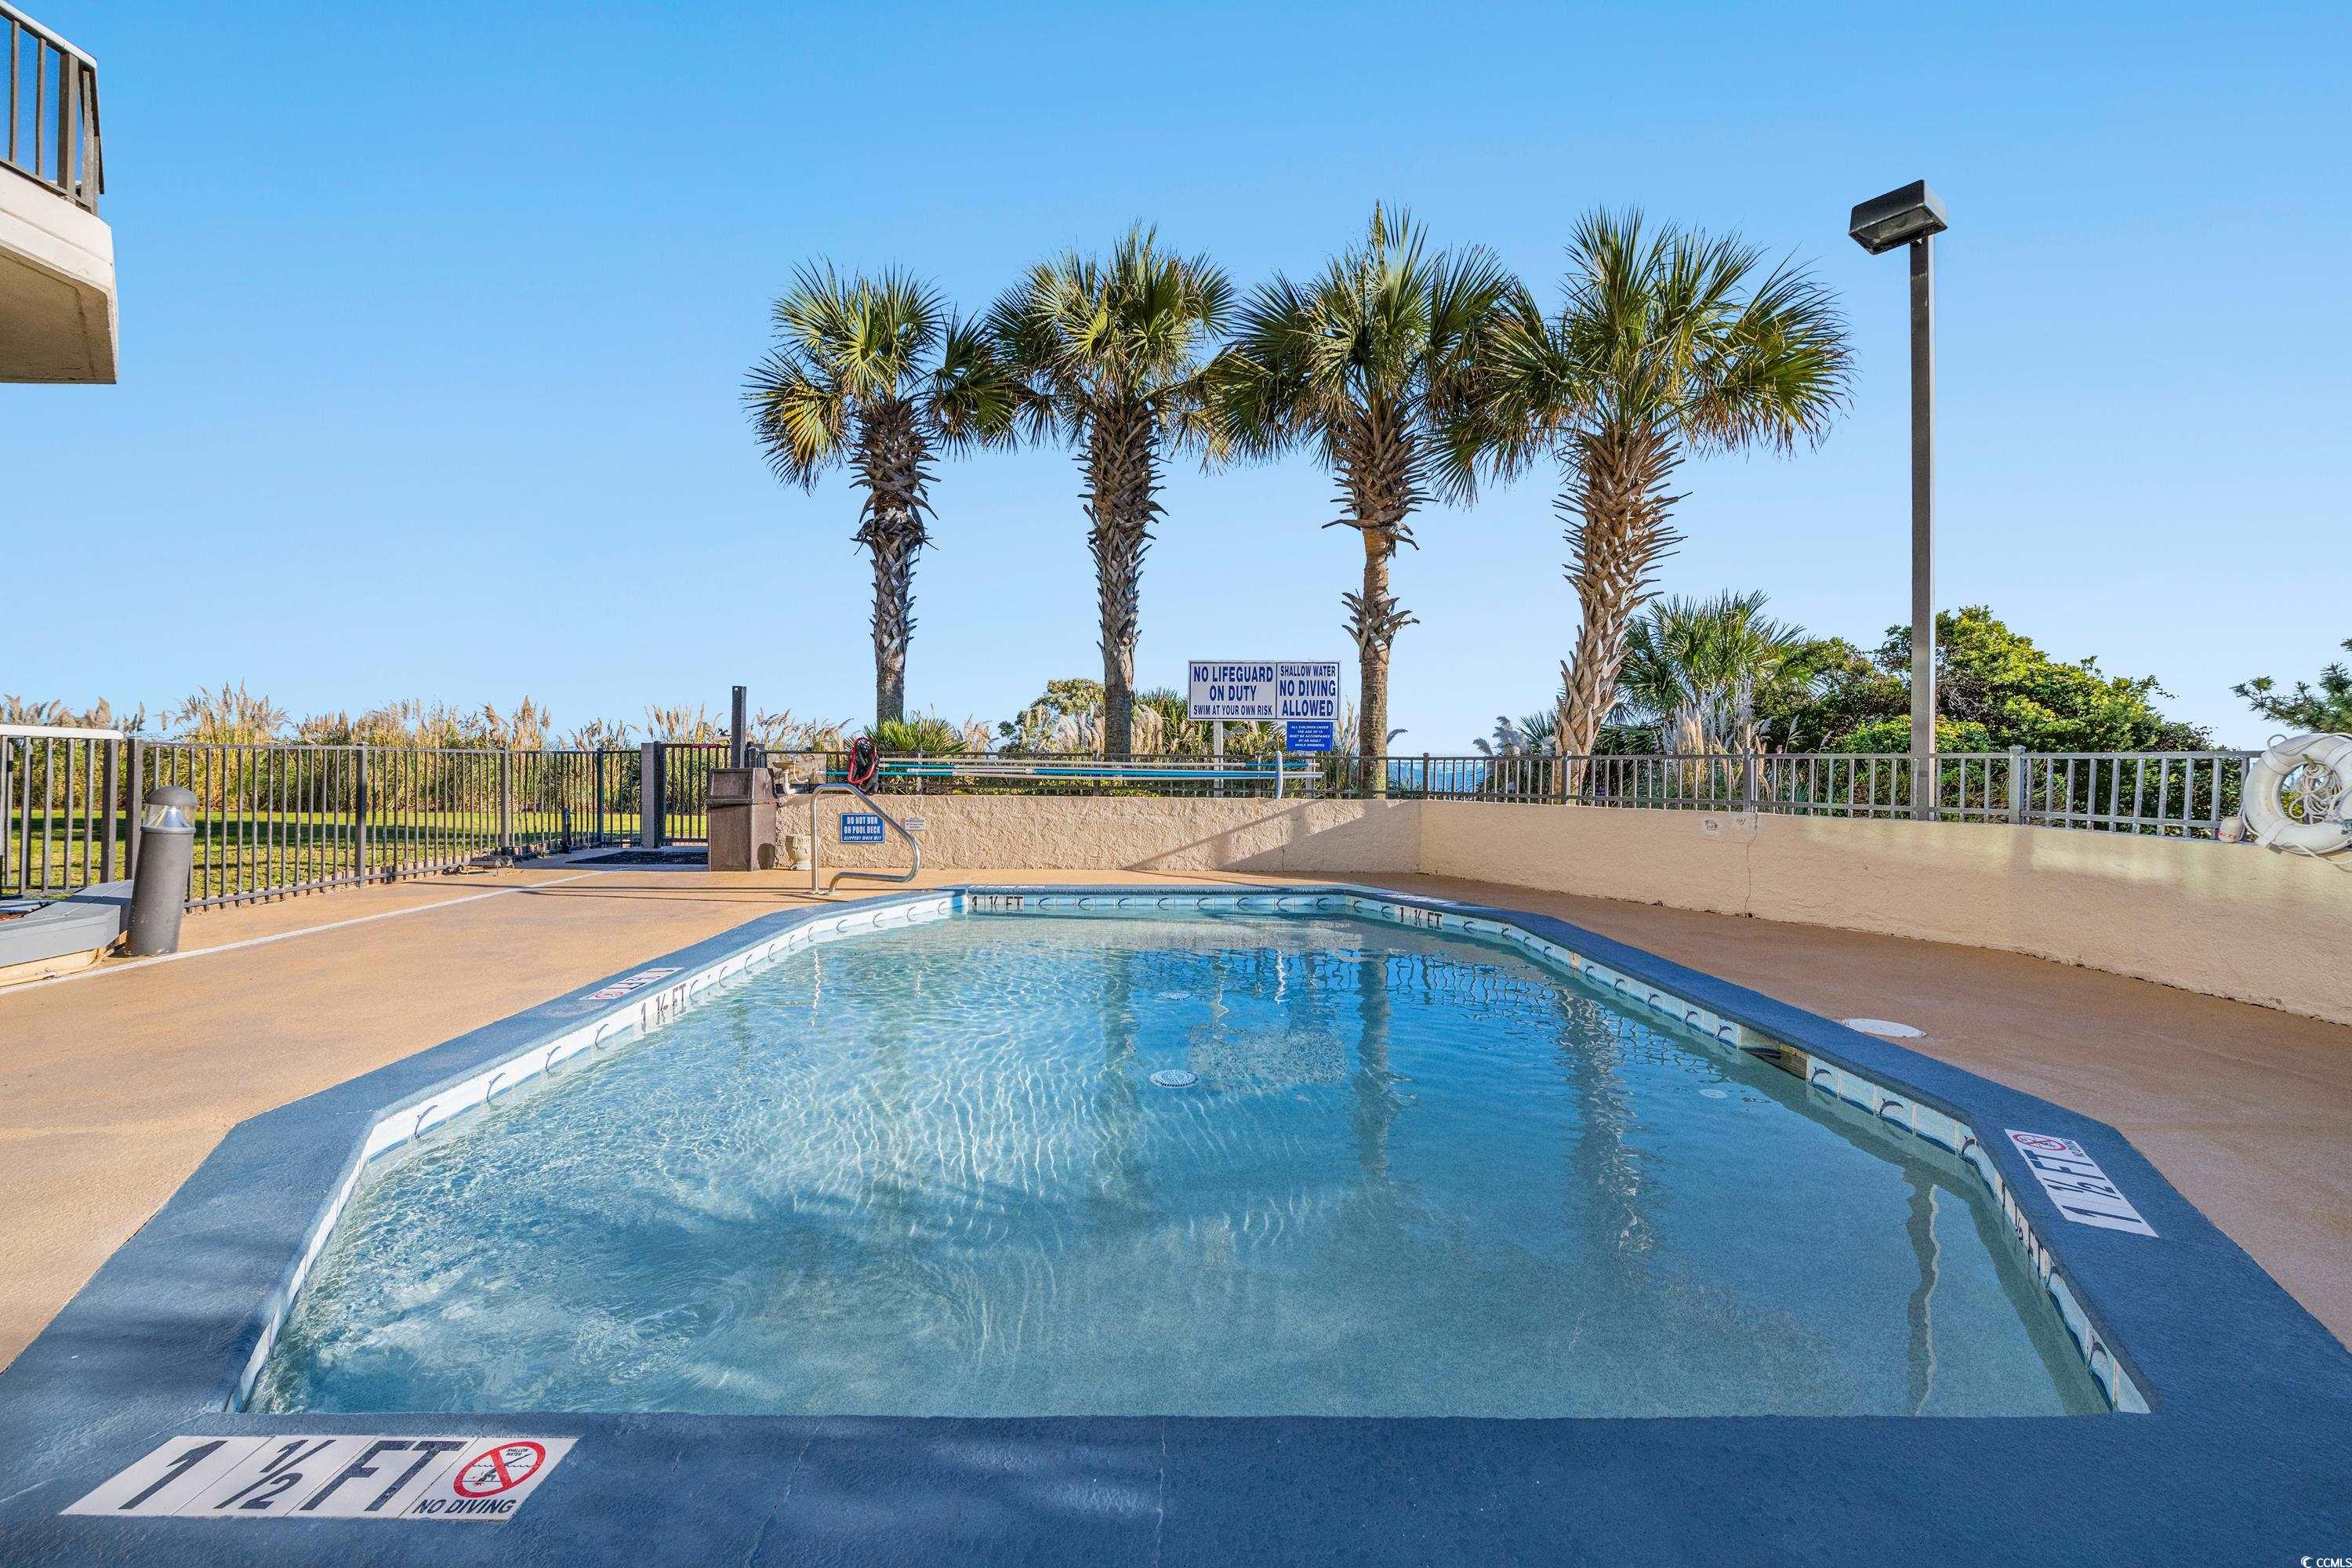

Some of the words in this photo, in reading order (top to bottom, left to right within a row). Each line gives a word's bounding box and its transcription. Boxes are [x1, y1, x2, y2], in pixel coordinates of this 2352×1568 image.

[1193, 666, 1209, 682] NO
[1212, 666, 1273, 682] LIFEGUARD
[1280, 666, 1311, 677] SHALLOW
[1313, 666, 1336, 677] WATER
[1210, 684, 1225, 701] ON
[1229, 685, 1257, 701] DUTY
[1279, 680, 1294, 696] NO
[1298, 680, 1336, 696] DIVING
[1193, 705, 1210, 715] SWIM
[1212, 705, 1220, 715] AT
[1222, 705, 1239, 715] YOUR
[1241, 705, 1255, 715] OWN
[1258, 705, 1272, 715] RISK
[1282, 699, 1334, 716] ALLOWED
[844, 826, 851, 834] ON
[1006, 896, 1023, 906] FT
[1428, 912, 1442, 924] FT
[673, 983, 687, 1007] FT
[2022, 1149, 2106, 1181] FT
[2061, 1205, 2142, 1224] 1
[118, 1440, 229, 1509] 1
[299, 1440, 468, 1511] FT
[411, 1499, 447, 1514] NO
[443, 1499, 517, 1514] DIVING
